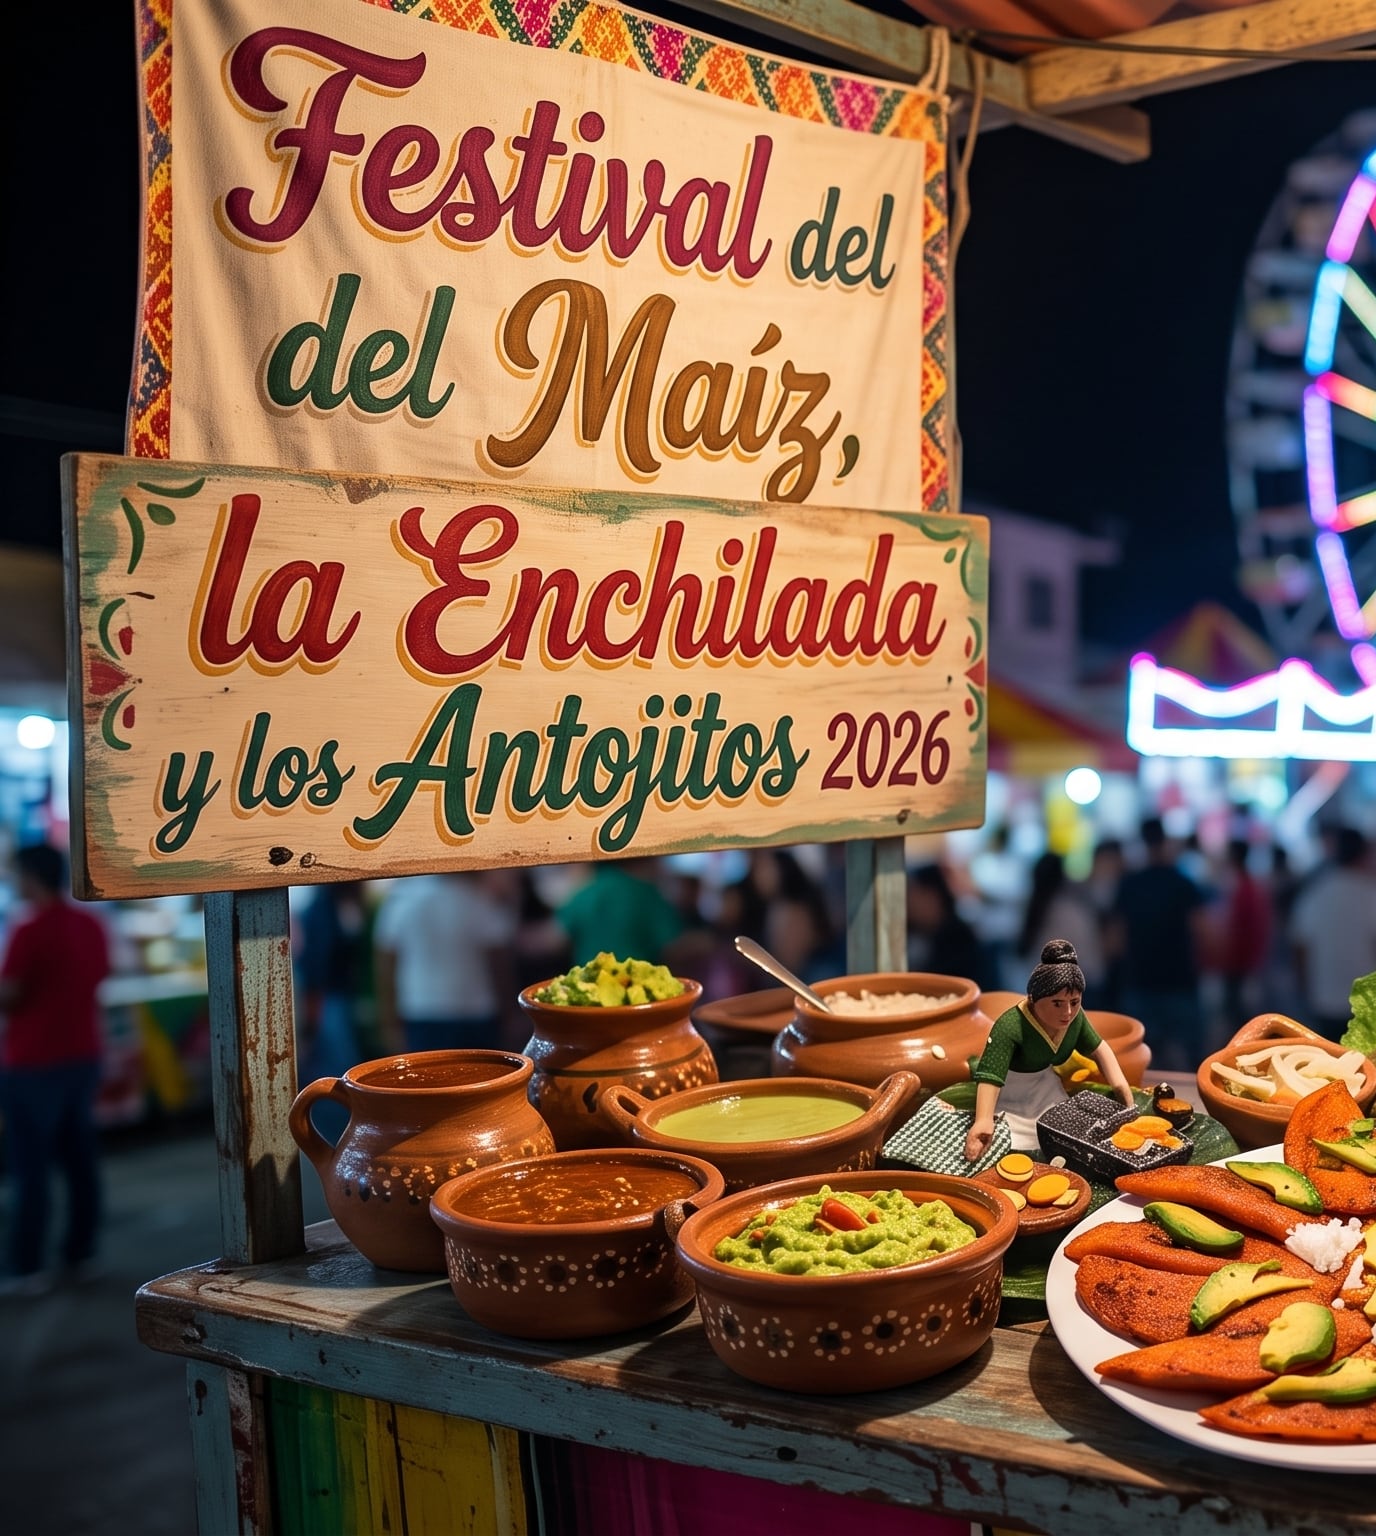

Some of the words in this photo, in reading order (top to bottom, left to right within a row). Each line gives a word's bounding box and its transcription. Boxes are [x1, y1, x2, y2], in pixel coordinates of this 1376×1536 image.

[225, 26, 773, 280] Festival
[789, 187, 897, 290] del
[266, 272, 457, 419] del
[486, 278, 860, 504] Maíz,
[198, 492, 362, 666] la
[399, 503, 947, 675] Enchilada
[155, 750, 222, 854] y
[237, 710, 356, 811] los
[352, 682, 811, 854] Antojitos
[820, 709, 951, 791] 2026
